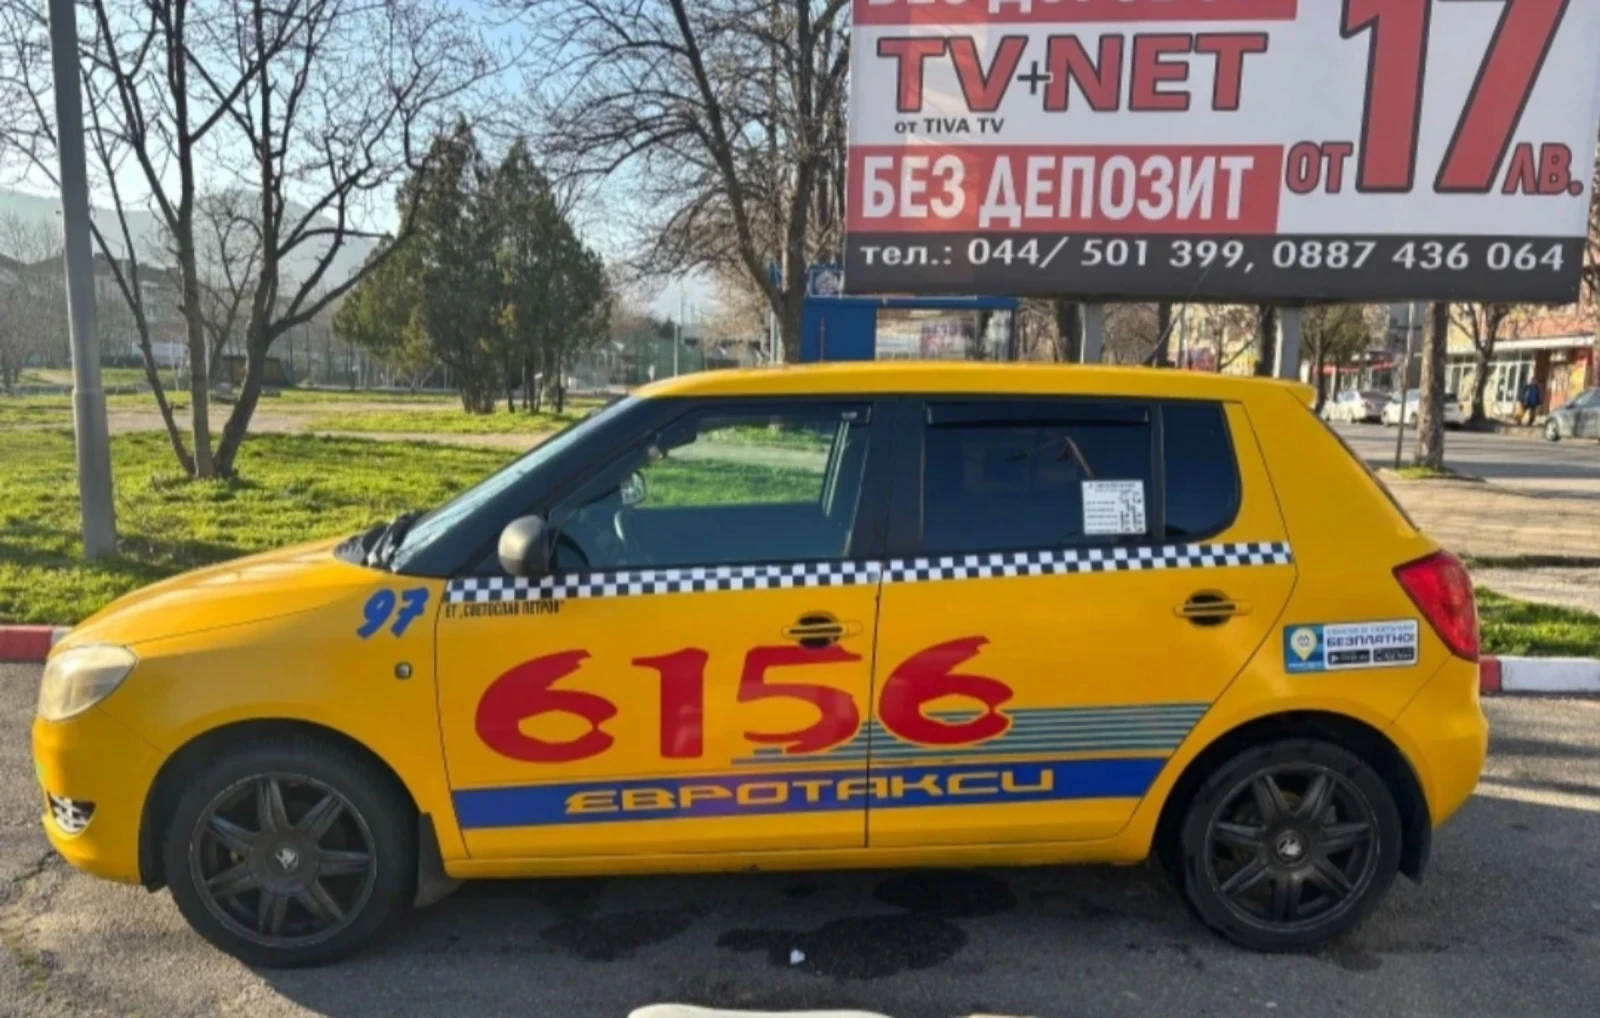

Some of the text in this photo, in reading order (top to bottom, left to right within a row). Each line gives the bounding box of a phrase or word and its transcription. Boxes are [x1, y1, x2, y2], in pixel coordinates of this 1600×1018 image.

[877, 32, 1269, 113] TV+NET
[1285, 0, 1584, 196] ОТ 17 ЛВ.
[894, 117, 1005, 134] от TIVA TV
[862, 154, 1255, 228] БЕЗ ДЕПОЗИТ
[860, 237, 1565, 272] тел.: 044/ 501 399, 0887 436 064
[356, 588, 429, 639] 97
[474, 635, 1014, 764] 6156
